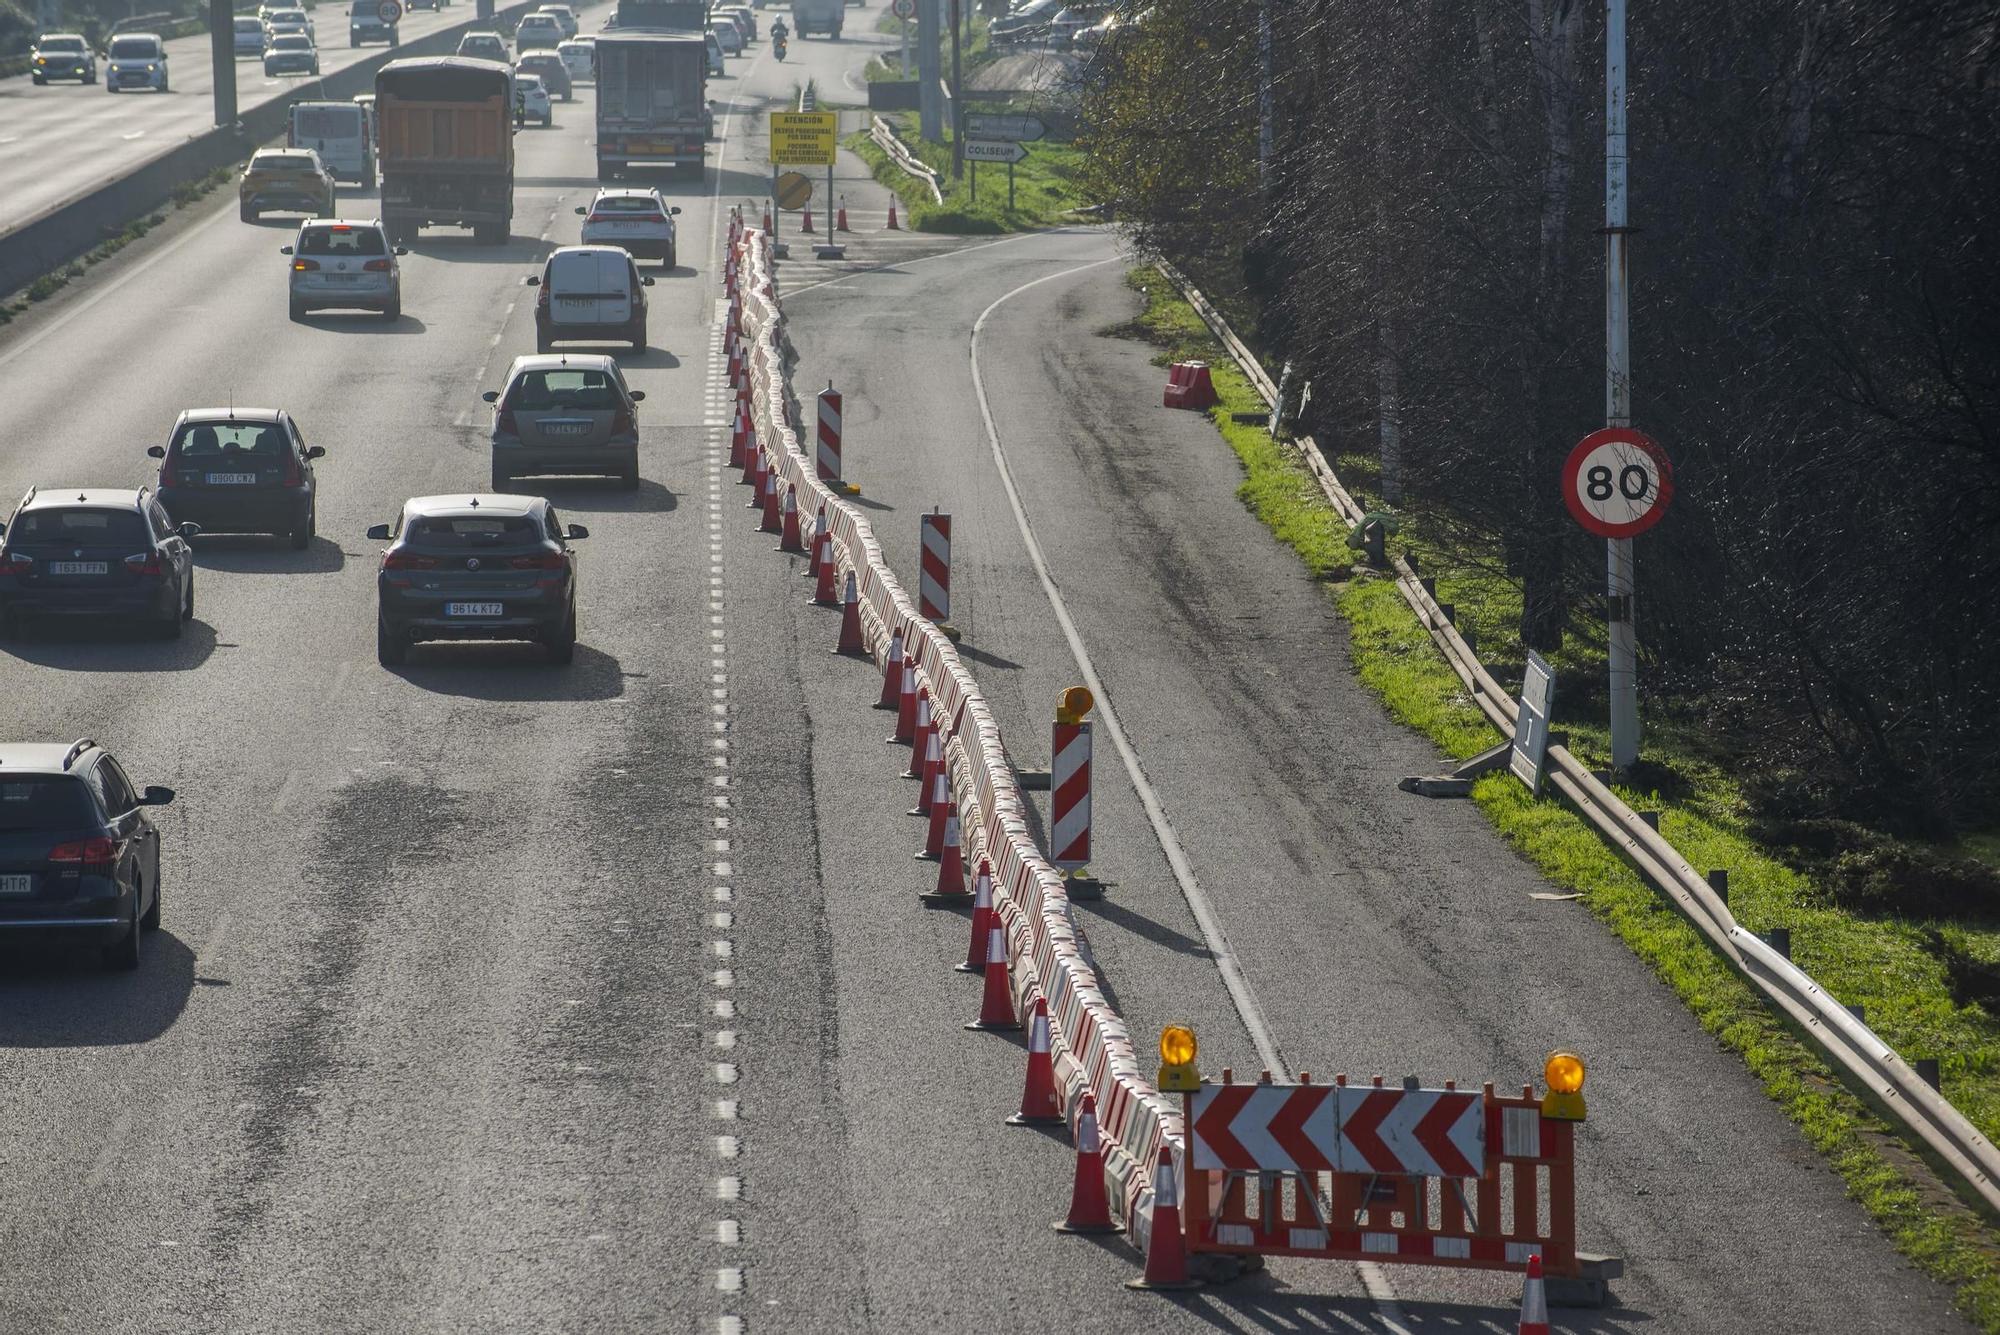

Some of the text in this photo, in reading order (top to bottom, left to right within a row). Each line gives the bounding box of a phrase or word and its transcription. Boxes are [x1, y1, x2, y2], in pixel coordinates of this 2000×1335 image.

[383, 6, 398, 16] 80
[968, 146, 1015, 156] COLISEUM
[1587, 464, 1649, 501] 80
[59, 563, 82, 573] 1631
[452, 603, 501, 614] 9614 KTZ
[0, 877, 28, 890] HTR
